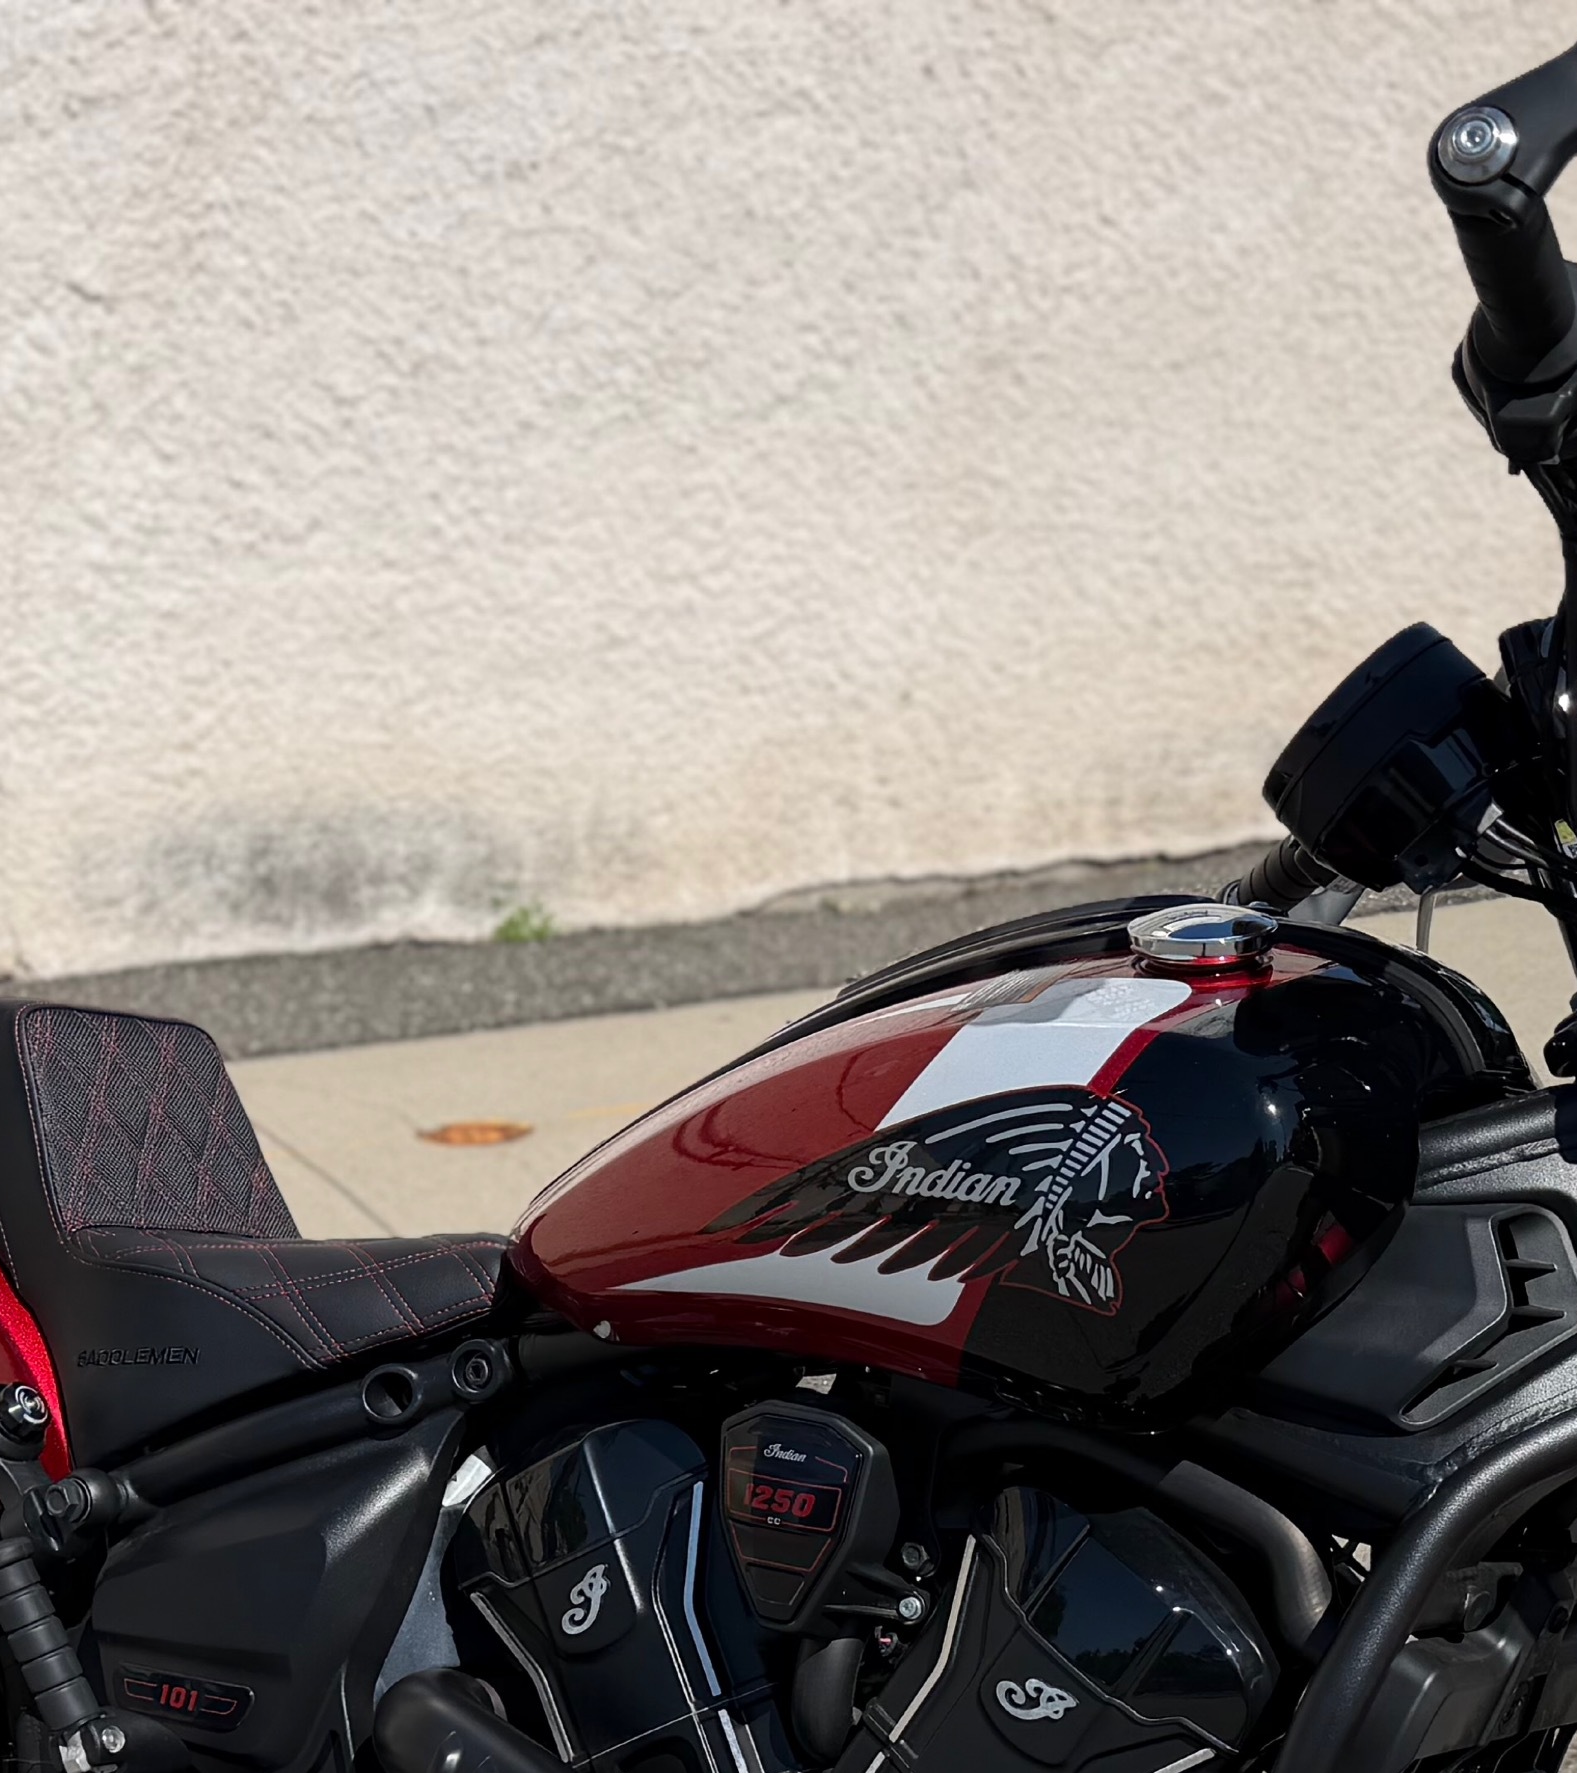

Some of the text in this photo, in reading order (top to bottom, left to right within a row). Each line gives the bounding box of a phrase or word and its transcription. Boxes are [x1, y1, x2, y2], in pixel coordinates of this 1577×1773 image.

[848, 1141, 1022, 1207] Indian
[764, 1443, 808, 1463] Indian
[743, 1482, 817, 1518] 1250
[159, 1684, 199, 1712] 101
